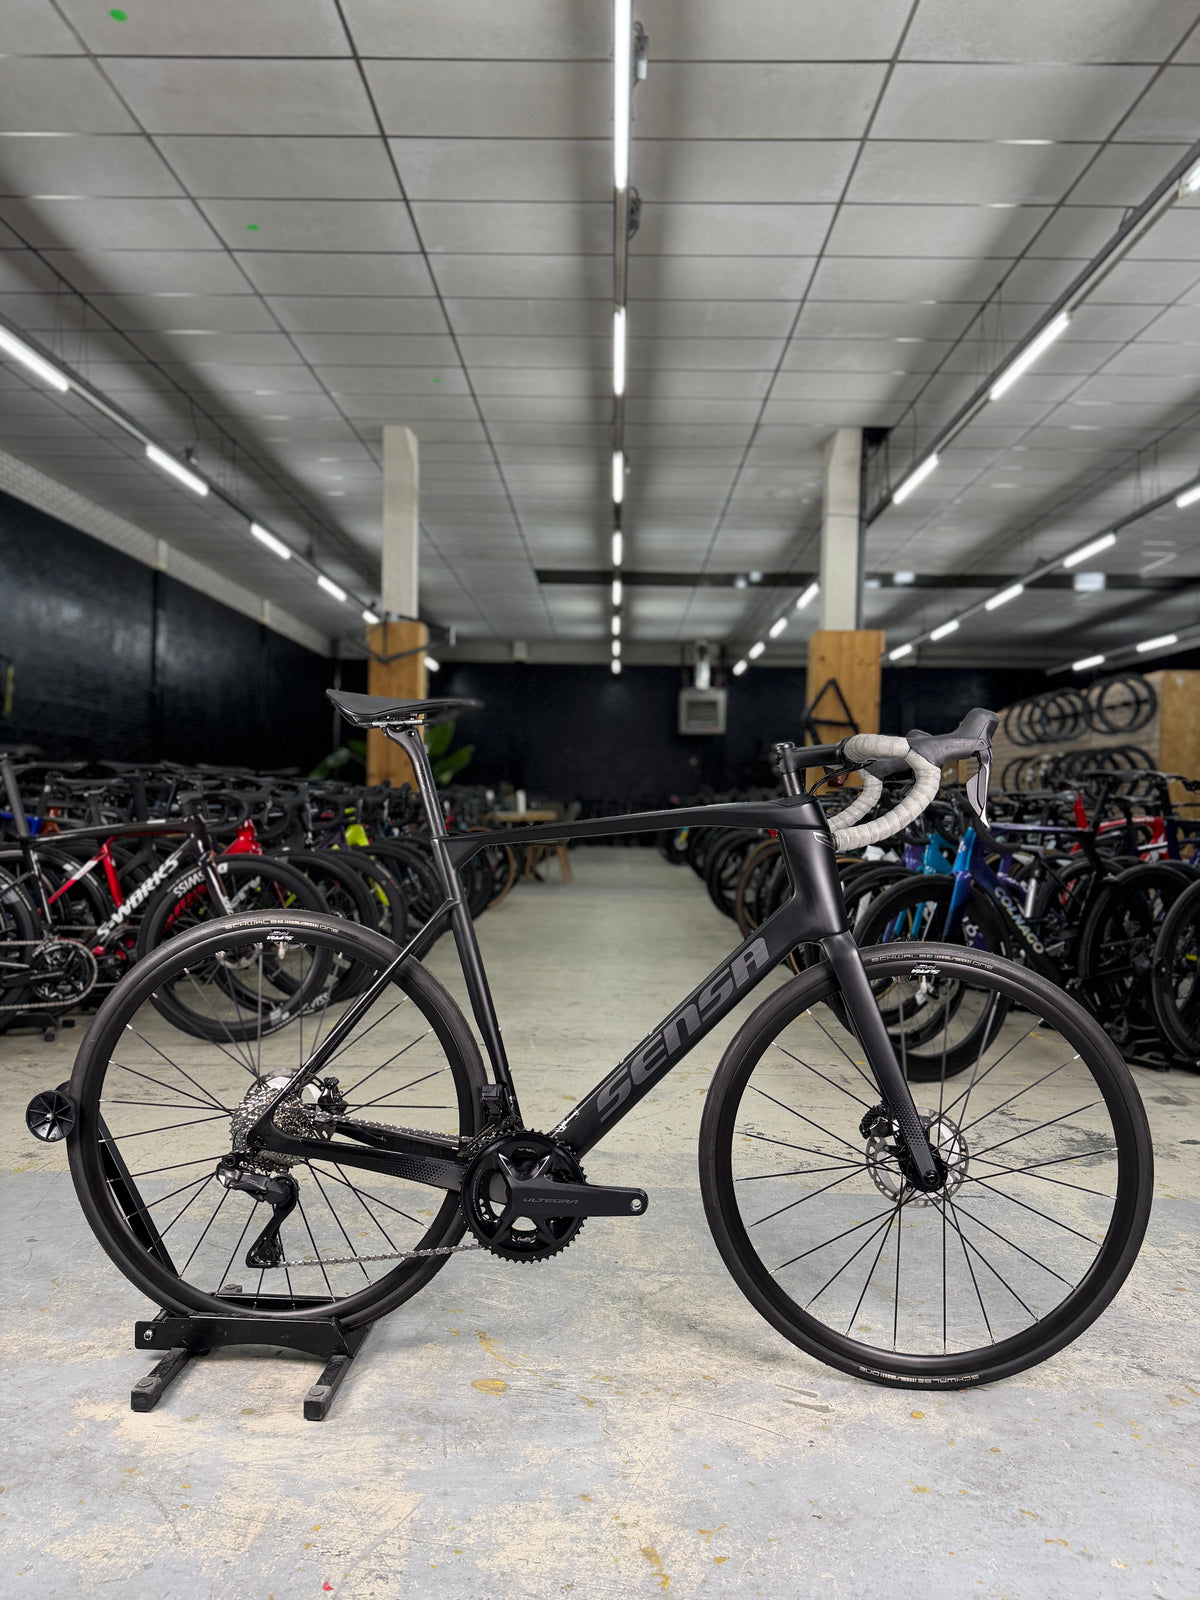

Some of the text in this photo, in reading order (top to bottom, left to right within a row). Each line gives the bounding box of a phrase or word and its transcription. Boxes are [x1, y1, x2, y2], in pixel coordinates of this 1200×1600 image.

[97, 851, 181, 942] S-WORKS
[994, 886, 1044, 954] COLNAGO
[871, 953, 933, 963] SCHWALBE
[917, 1374, 980, 1384] SCHWALBE
